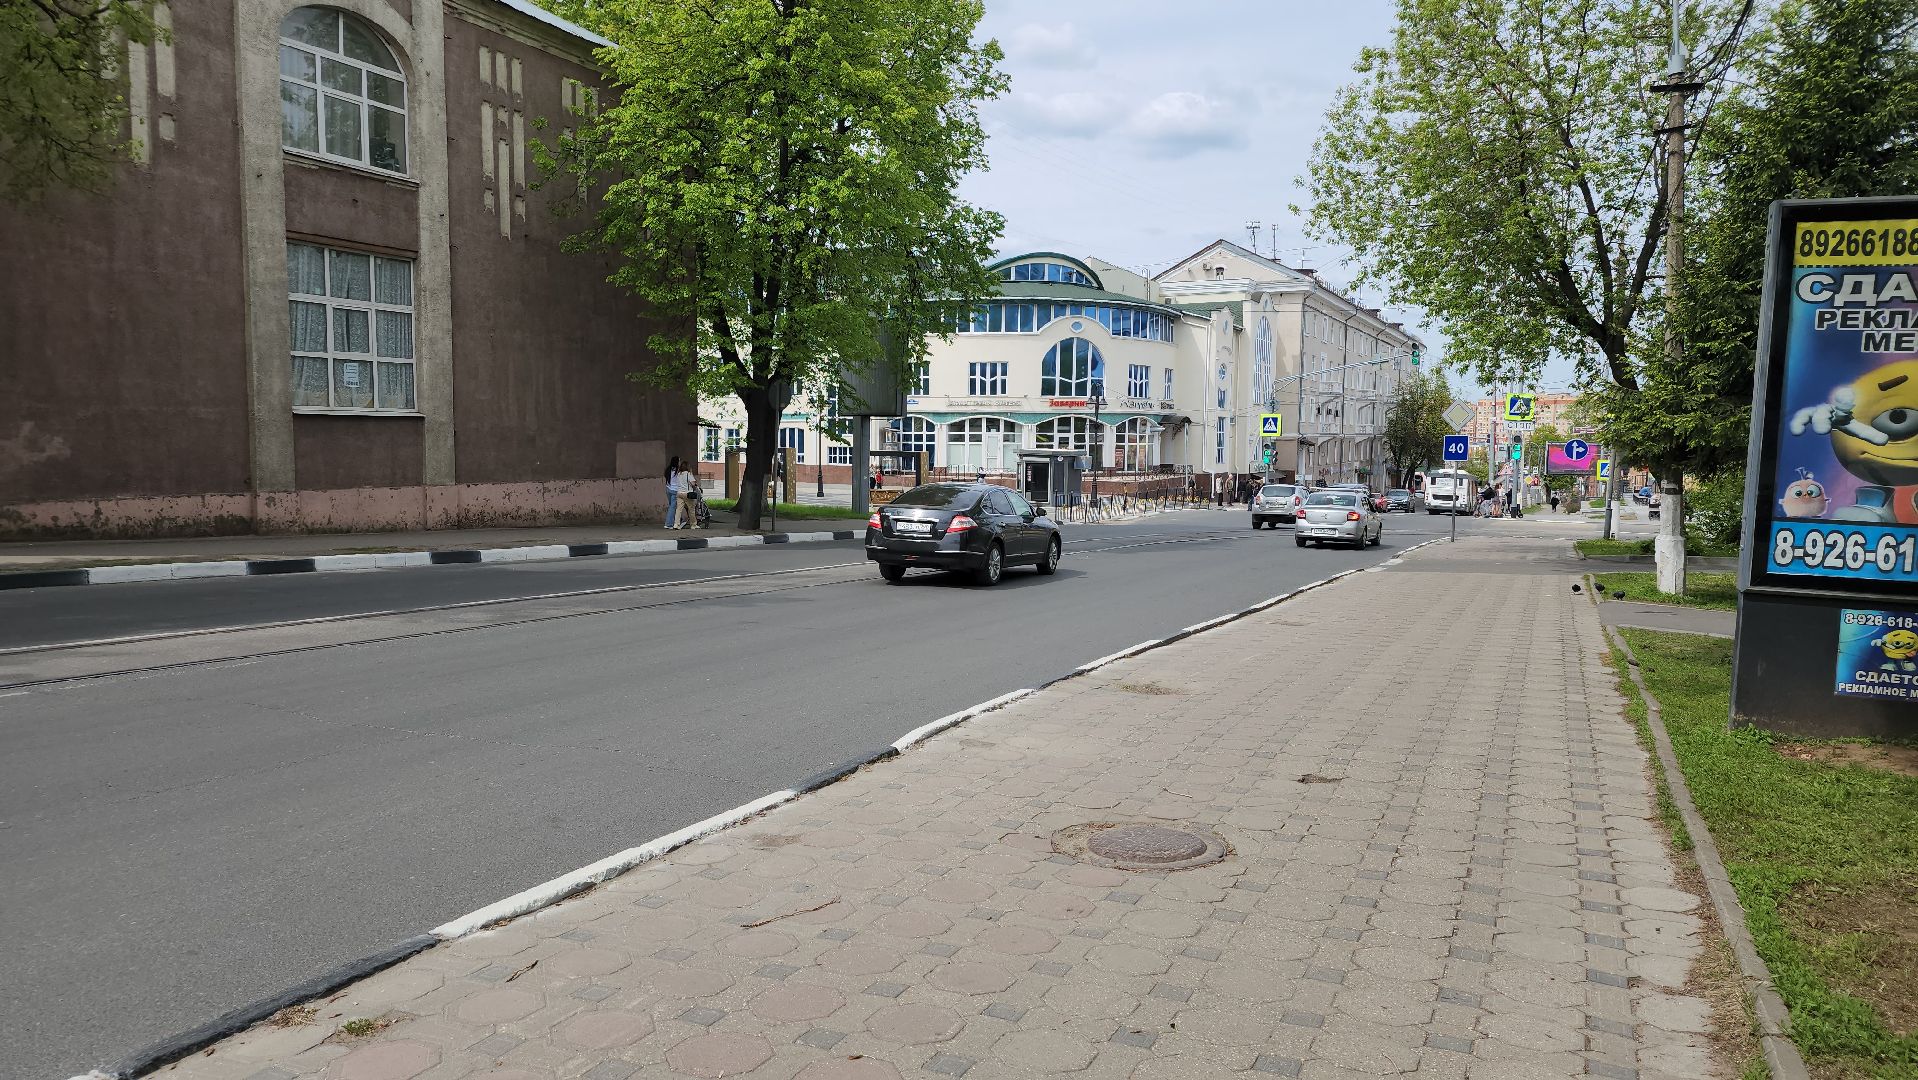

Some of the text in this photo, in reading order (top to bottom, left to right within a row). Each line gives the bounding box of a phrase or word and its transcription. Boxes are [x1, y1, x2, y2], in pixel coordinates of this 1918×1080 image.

[1798, 273, 1918, 307] СДА
[1863, 332, 1915, 351] МЕ
[1448, 443, 1465, 454] 40
[1773, 530, 1916, 573] 8-926-61
[1838, 683, 1907, 697] РЕКЛАМНОЕ
